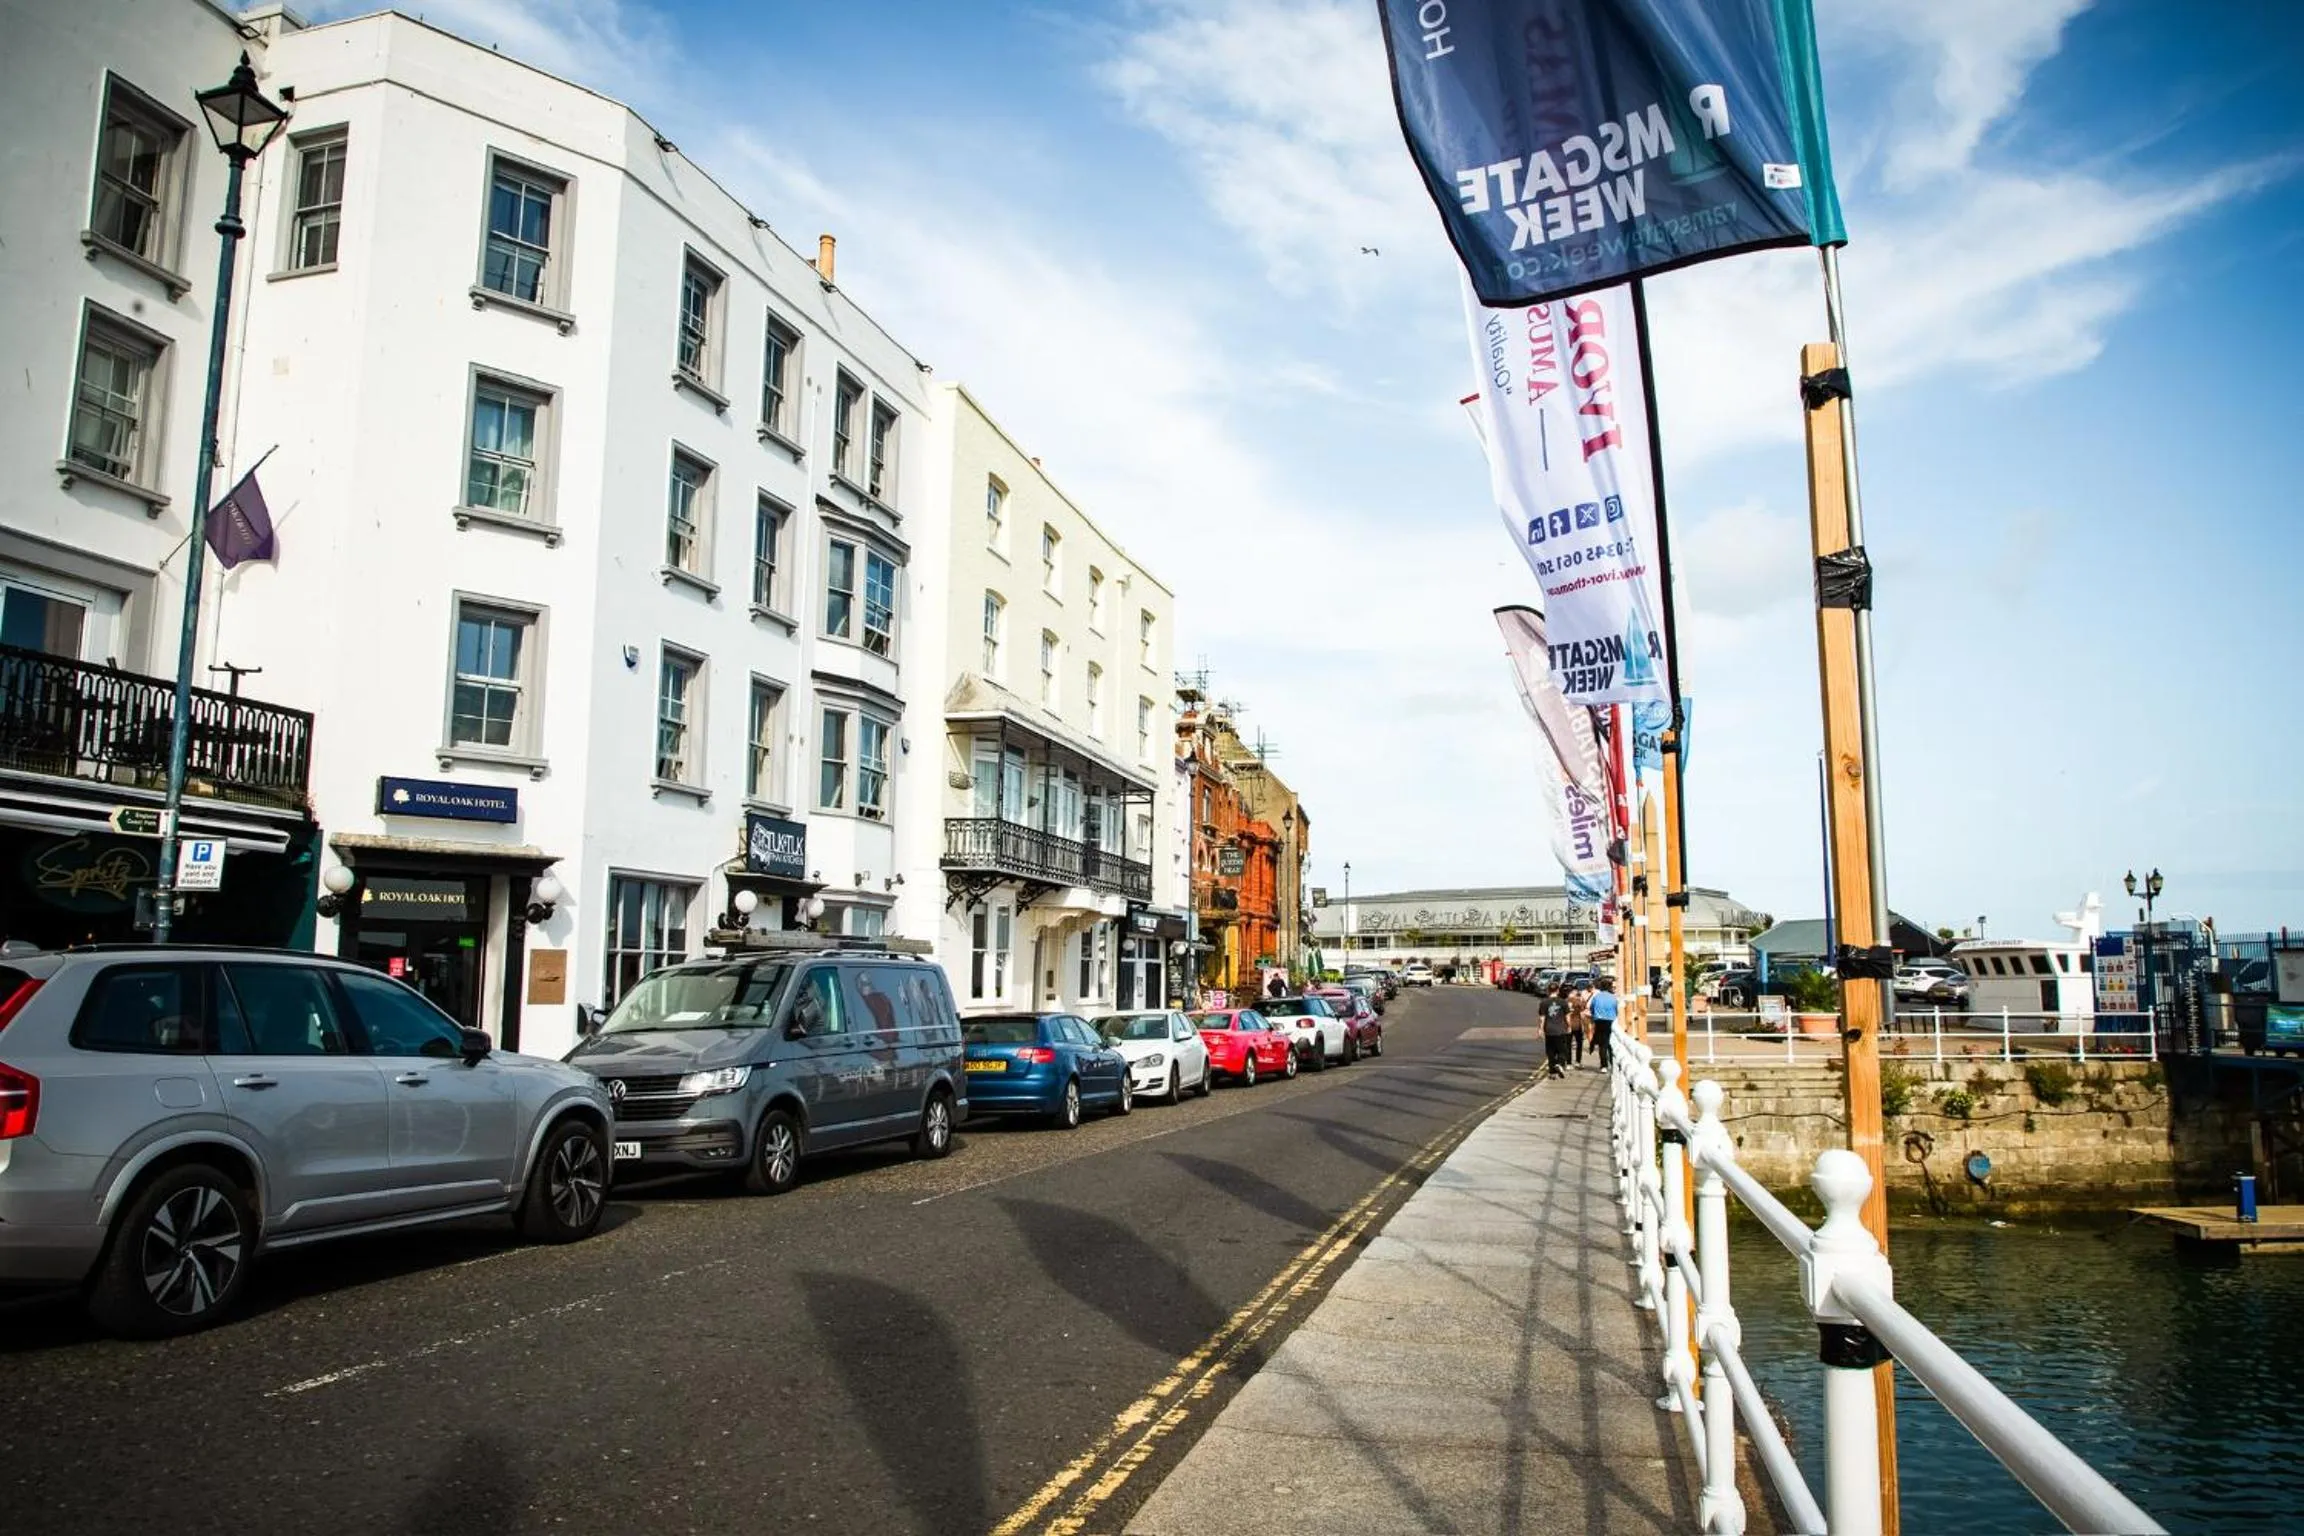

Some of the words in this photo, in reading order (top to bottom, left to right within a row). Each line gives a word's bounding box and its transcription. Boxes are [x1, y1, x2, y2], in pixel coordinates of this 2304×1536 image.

[415, 793, 450, 804] ROYAL
[451, 797, 474, 807] OAK
[474, 799, 508, 809] HOTEL
[196, 844, 210, 861] P
[379, 891, 416, 903] ROYAL
[417, 893, 443, 903] OAK
